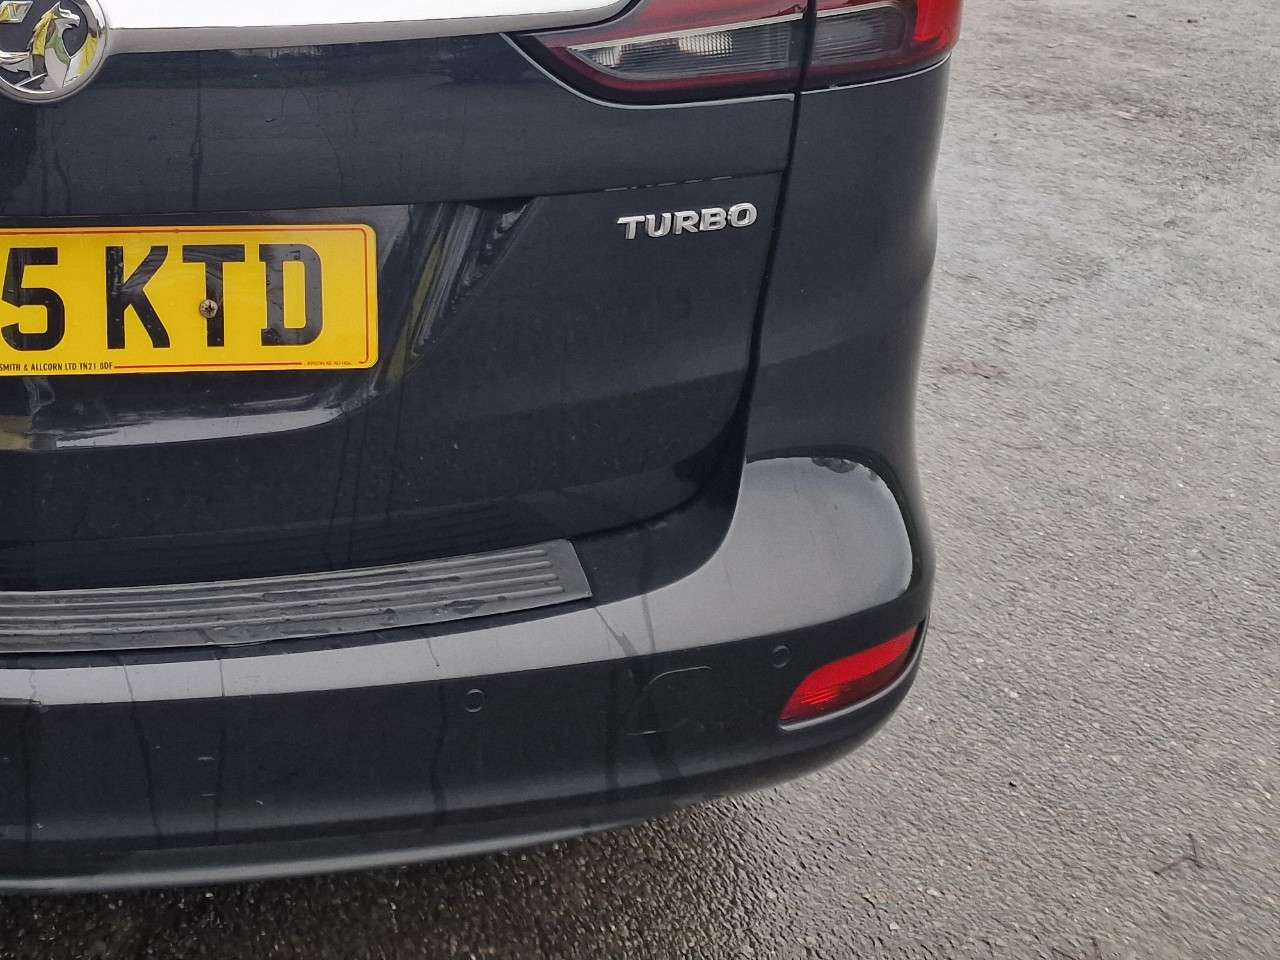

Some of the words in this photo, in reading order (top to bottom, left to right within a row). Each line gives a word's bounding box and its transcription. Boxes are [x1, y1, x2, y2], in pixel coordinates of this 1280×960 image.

[617, 202, 758, 240] TURBO
[105, 243, 323, 350] KTD
[31, 363, 63, 371] ALLCORN
[65, 362, 77, 370] LTD
